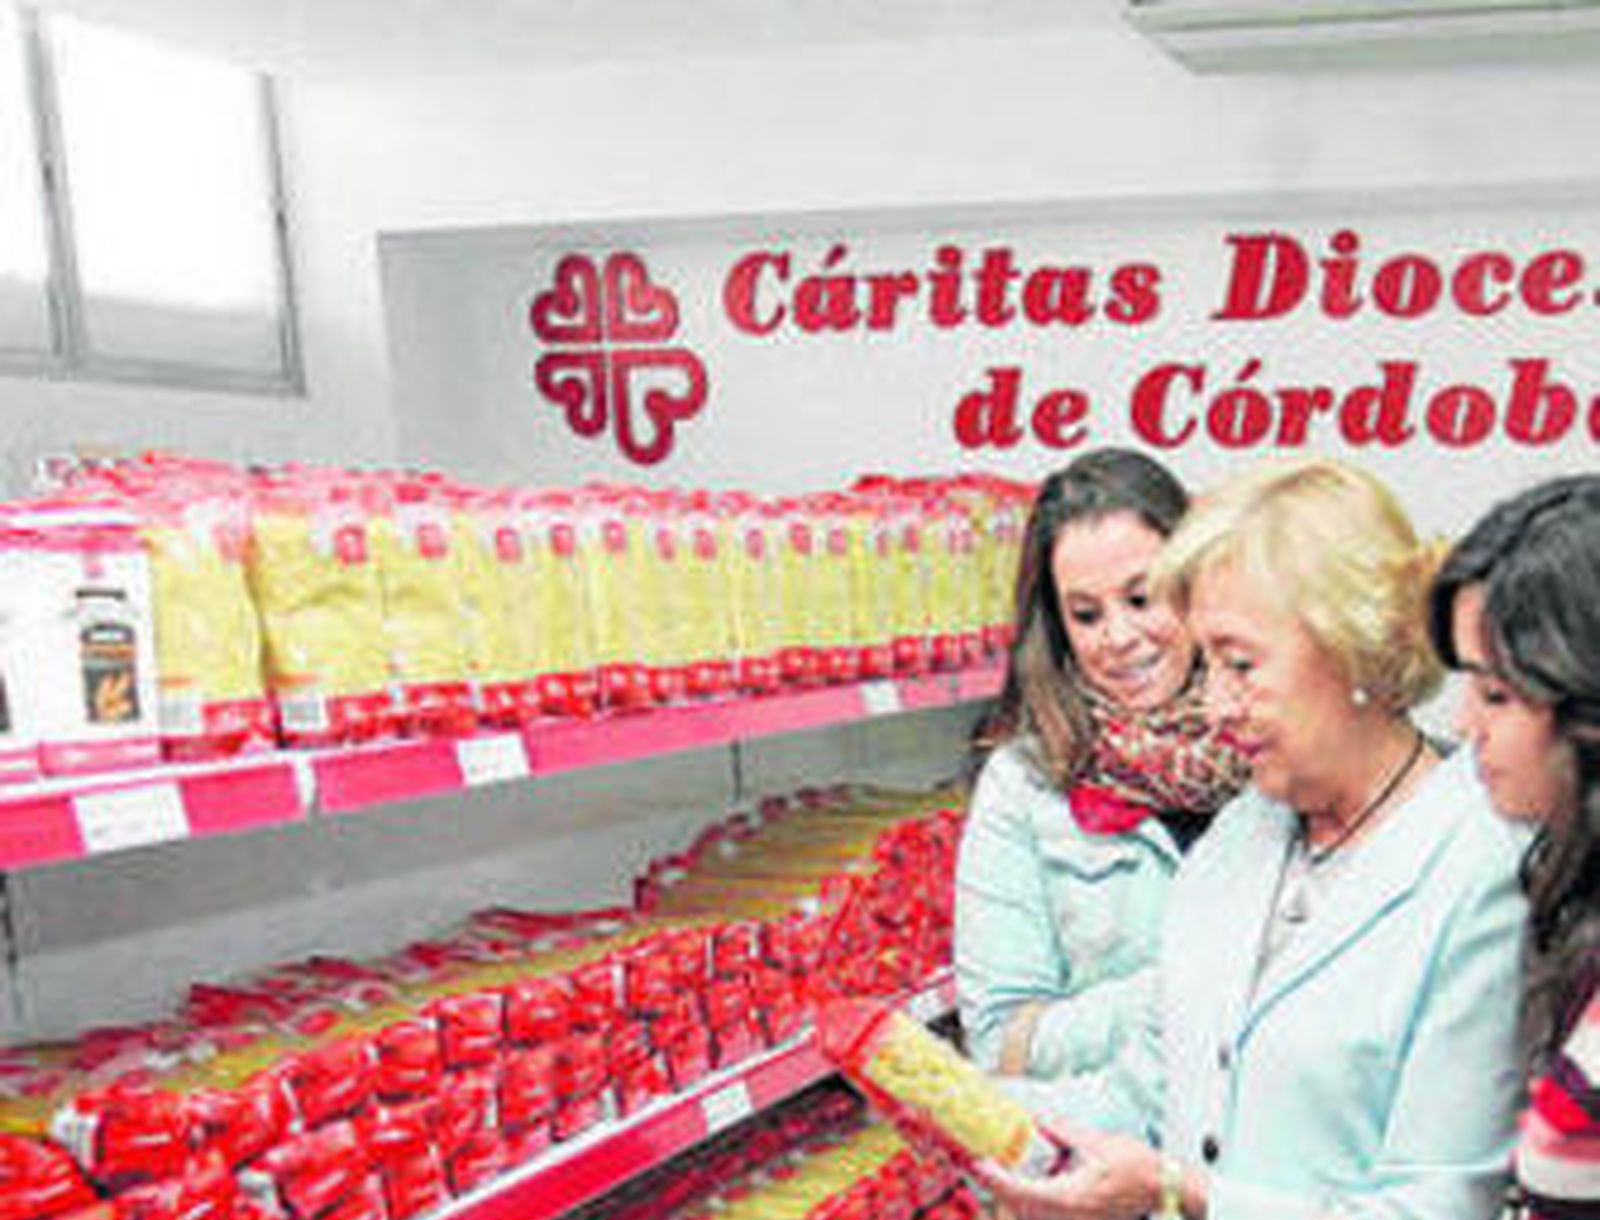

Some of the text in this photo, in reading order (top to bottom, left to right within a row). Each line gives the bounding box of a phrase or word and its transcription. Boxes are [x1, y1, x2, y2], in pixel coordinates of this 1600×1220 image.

[722, 230, 1600, 338] Cáritas Dioce
[952, 357, 1600, 449] de Córdob
